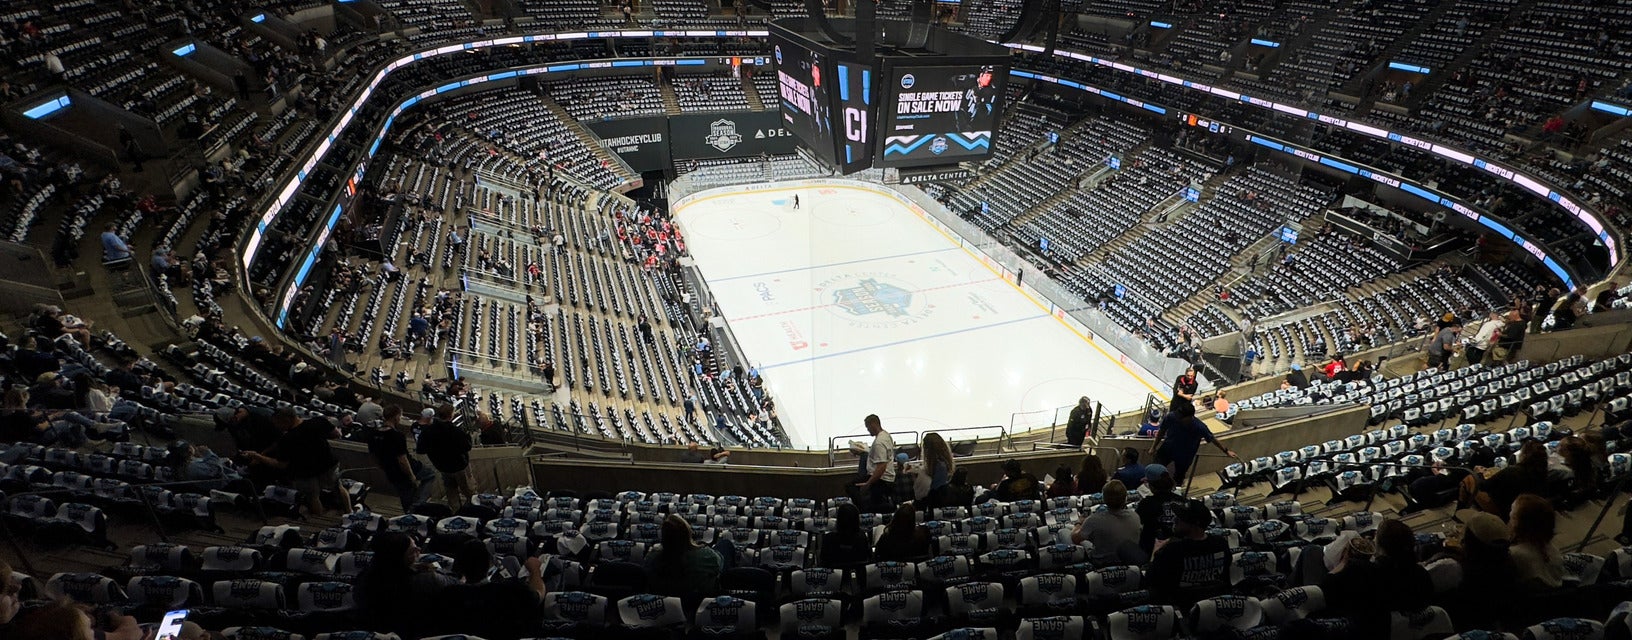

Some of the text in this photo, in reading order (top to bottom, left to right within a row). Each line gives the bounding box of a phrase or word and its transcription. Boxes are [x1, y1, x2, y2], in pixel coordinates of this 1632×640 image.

[898, 91, 963, 102] SINGLE GAME TICKETS
[897, 99, 962, 114] ON SALE NOW
[712, 129, 735, 137] SEASON
[911, 171, 968, 182] DELTA CENTER
[1184, 553, 1214, 571] UTAH
[806, 571, 827, 580] GAME
[1103, 569, 1127, 579] GAME
[1181, 567, 1225, 584] HOCKEY
[233, 579, 261, 590] GAME
[1038, 576, 1063, 586] GAME
[963, 585, 988, 595] GAME
[1277, 586, 1305, 603] GAME
[314, 591, 342, 601] GAME
[880, 592, 906, 602] GAME
[561, 602, 588, 613] GAME
[637, 599, 665, 613] GAME
[797, 602, 824, 611] GAME
[1216, 598, 1244, 609] GAME
[712, 606, 738, 616] GAME
[1128, 612, 1157, 623] GAME
[1034, 621, 1065, 632] GAME
